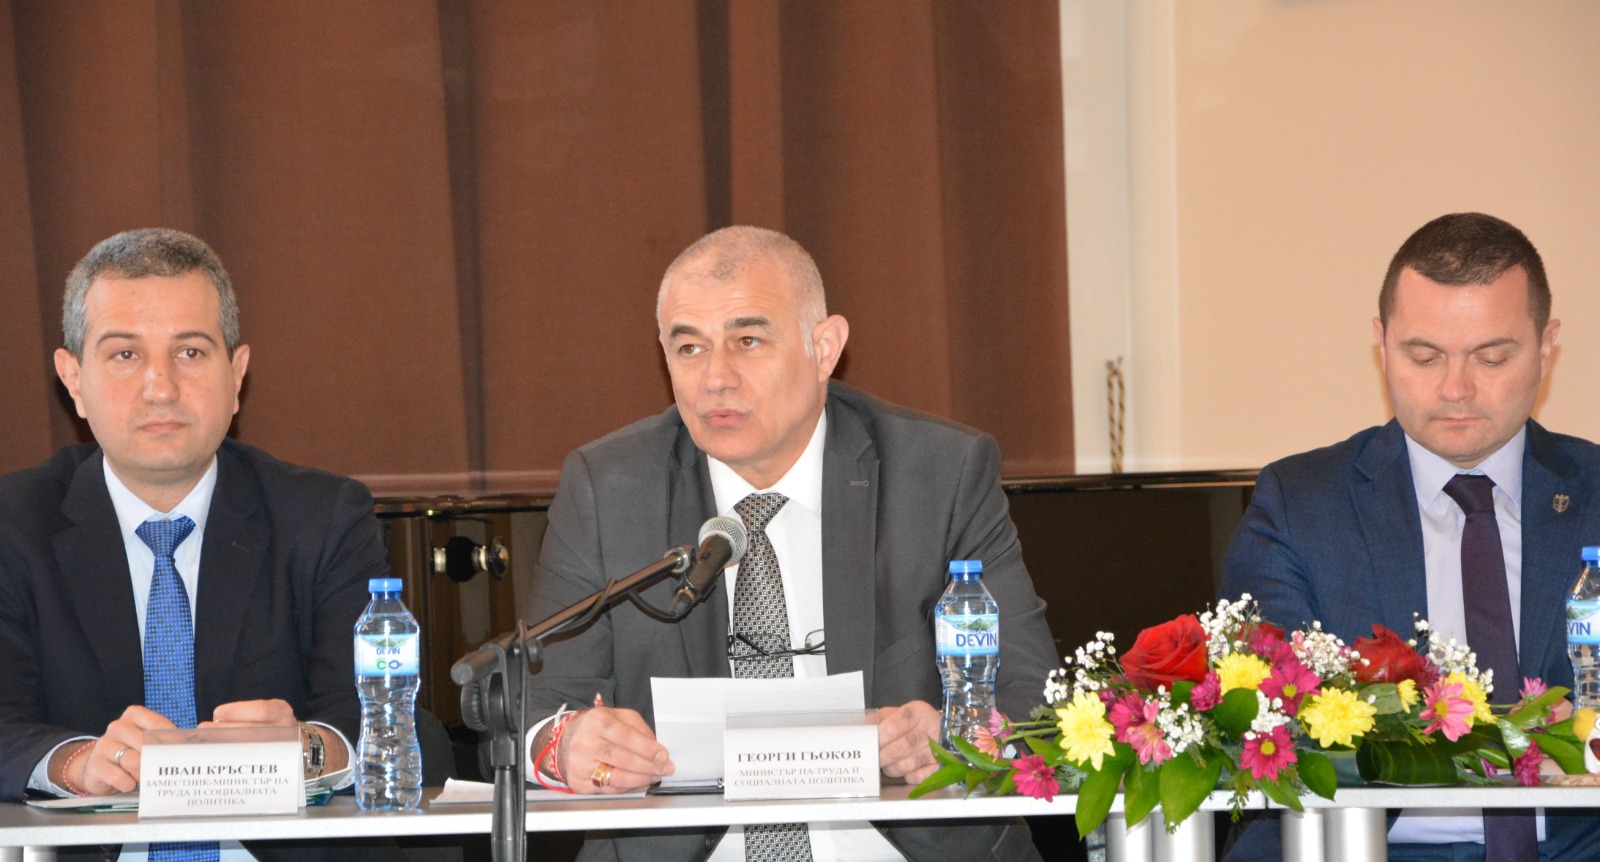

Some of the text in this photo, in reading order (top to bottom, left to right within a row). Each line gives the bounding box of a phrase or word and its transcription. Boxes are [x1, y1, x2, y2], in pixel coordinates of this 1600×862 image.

[956, 632, 997, 647] DEVIN
[738, 750, 862, 762] ГЕОРГИ ГЬОКОВ
[158, 764, 278, 776] ИВАН КРЪСТЕВ
[740, 768, 797, 777] МИНИСТЪР
[817, 767, 850, 776] ТРУДА
[145, 777, 289, 788] ЗАМЕСТНИК-МИНИСТЪР НА
[734, 776, 865, 787] СОЦИАЛНАТА ПОЛИТИКА
[157, 789, 190, 798] ТРУДА
[203, 787, 277, 796] СОЦИАЛНАТА
[187, 798, 246, 806] ПОЛИТИКА
